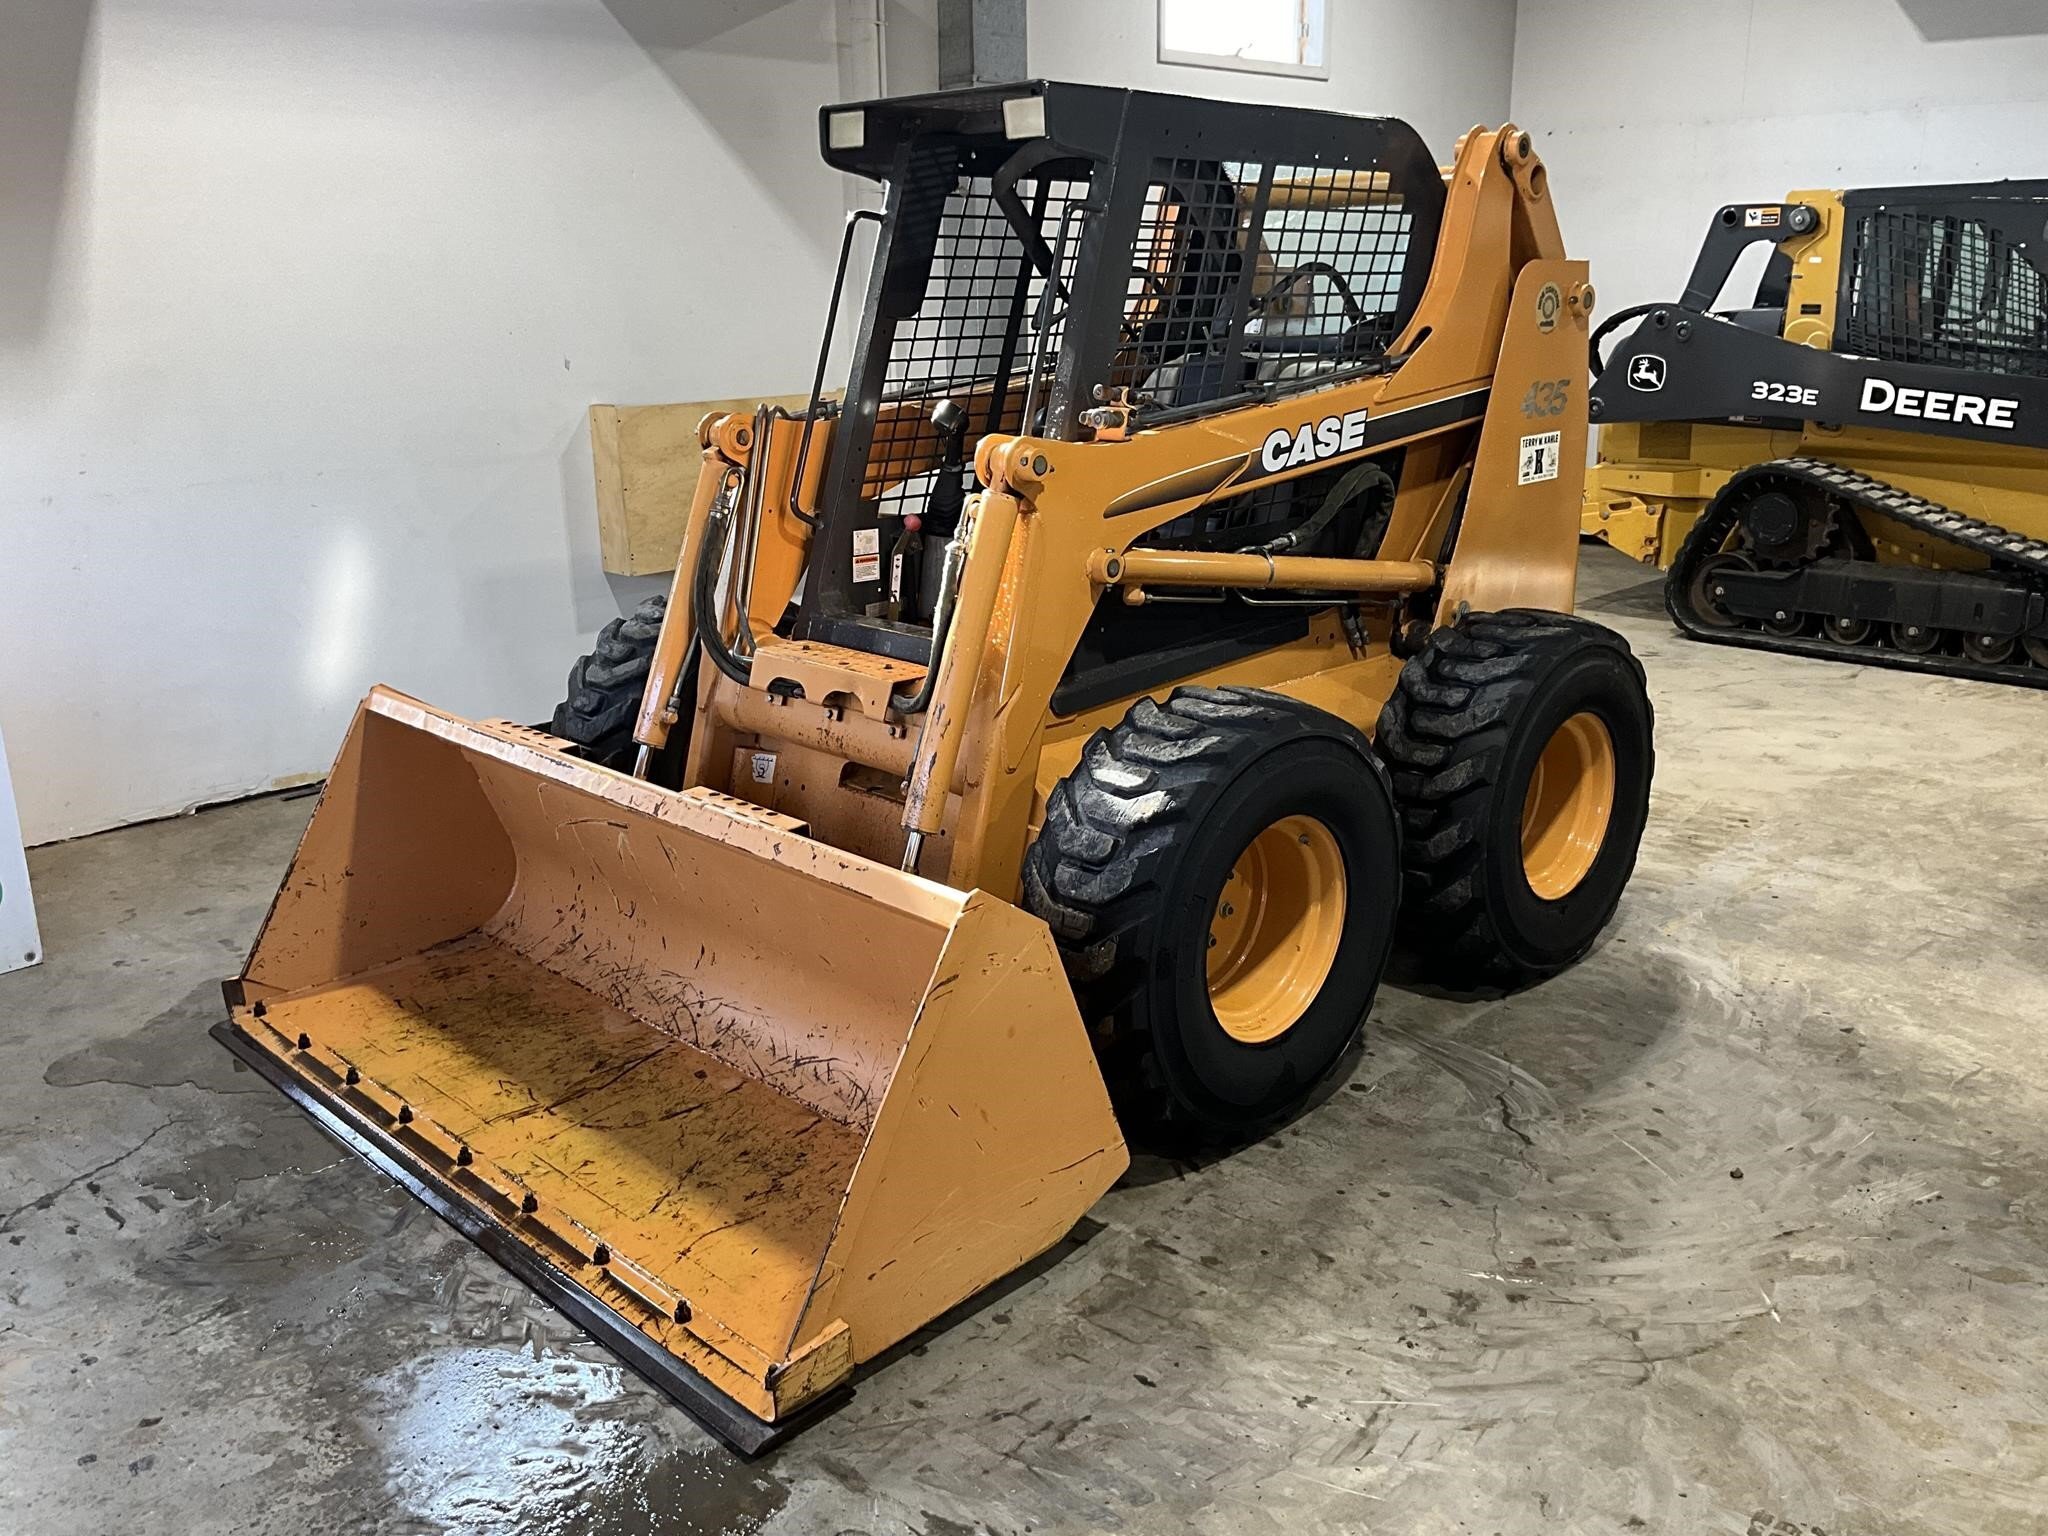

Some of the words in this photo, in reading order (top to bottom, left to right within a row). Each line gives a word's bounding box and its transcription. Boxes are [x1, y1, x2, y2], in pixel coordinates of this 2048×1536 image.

[1520, 379, 1570, 416] 435
[1751, 381, 1819, 406] 323E
[1860, 378, 2019, 428] DEERE
[1262, 409, 1367, 472] CASE
